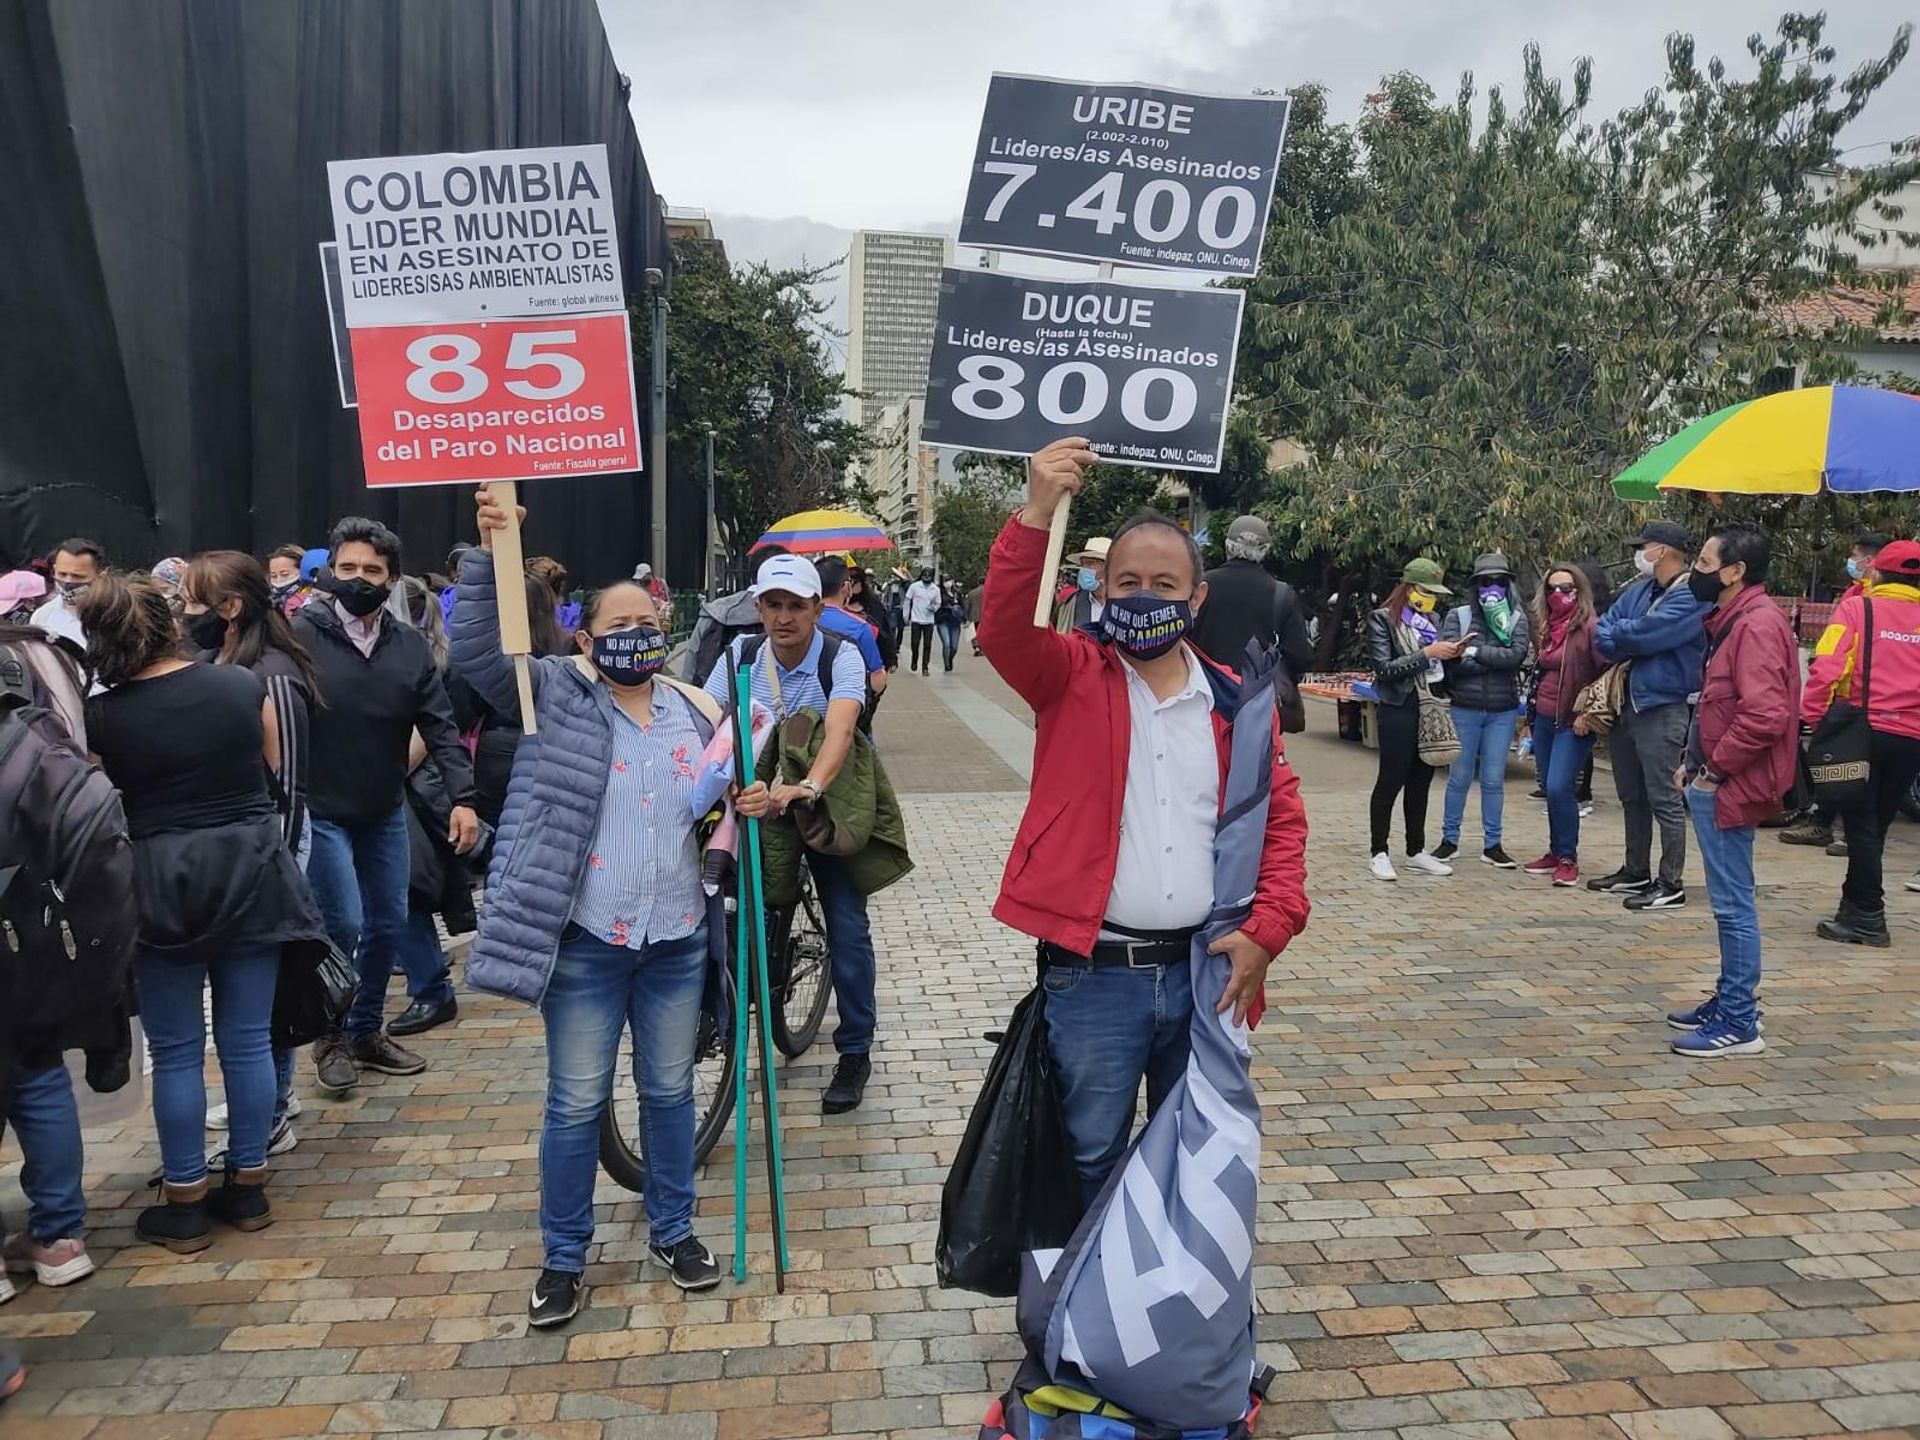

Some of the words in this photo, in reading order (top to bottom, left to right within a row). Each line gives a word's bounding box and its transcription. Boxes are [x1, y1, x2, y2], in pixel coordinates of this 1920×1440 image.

[1072, 96, 1195, 134] URIBE
[1086, 130, 1169, 150] (2.002-2.010)
[989, 137, 1111, 164] Lideres/as
[1116, 149, 1262, 180] Asesinados
[344, 161, 600, 214] COLOMBIA
[983, 161, 1256, 249] 7.400
[346, 216, 443, 250] LIDER
[454, 208, 607, 242] MUNDIAL
[351, 254, 389, 275] EN
[397, 243, 562, 271] ASESINATO
[573, 240, 611, 260] DE
[1120, 242, 1155, 258] Fuente:
[1197, 252, 1220, 265] ONU,
[1223, 254, 1252, 269] Cinep.
[353, 270, 464, 299] LIDERES/SAS
[469, 263, 614, 290] AMBIENTALISTAS
[529, 297, 561, 308] Fuente:
[562, 295, 587, 308] global
[589, 293, 619, 304] witness
[1022, 291, 1154, 328] DUQUE
[947, 326, 1069, 356] Lideres/as
[1074, 338, 1219, 367] Asesinados
[1035, 328, 1075, 339] (Hasta
[1079, 328, 1089, 337] la
[1093, 328, 1133, 342] fecha)
[406, 330, 586, 404] 85
[952, 355, 1198, 432] 800
[393, 403, 605, 431] Desaparecidos
[377, 440, 420, 462] del
[430, 437, 497, 460] Paro
[505, 428, 626, 456] Nacional
[1160, 447, 1184, 463] ONU,
[1186, 450, 1216, 467] Cinep.
[534, 460, 564, 471] Fuente:
[598, 455, 627, 470] general
[1128, 619, 1185, 651] CAMBIAR
[1132, 613, 1149, 628] QUE
[599, 654, 614, 667] HAY
[615, 655, 632, 669] QUE
[606, 638, 617, 650] NO
[618, 638, 635, 651] HAY
